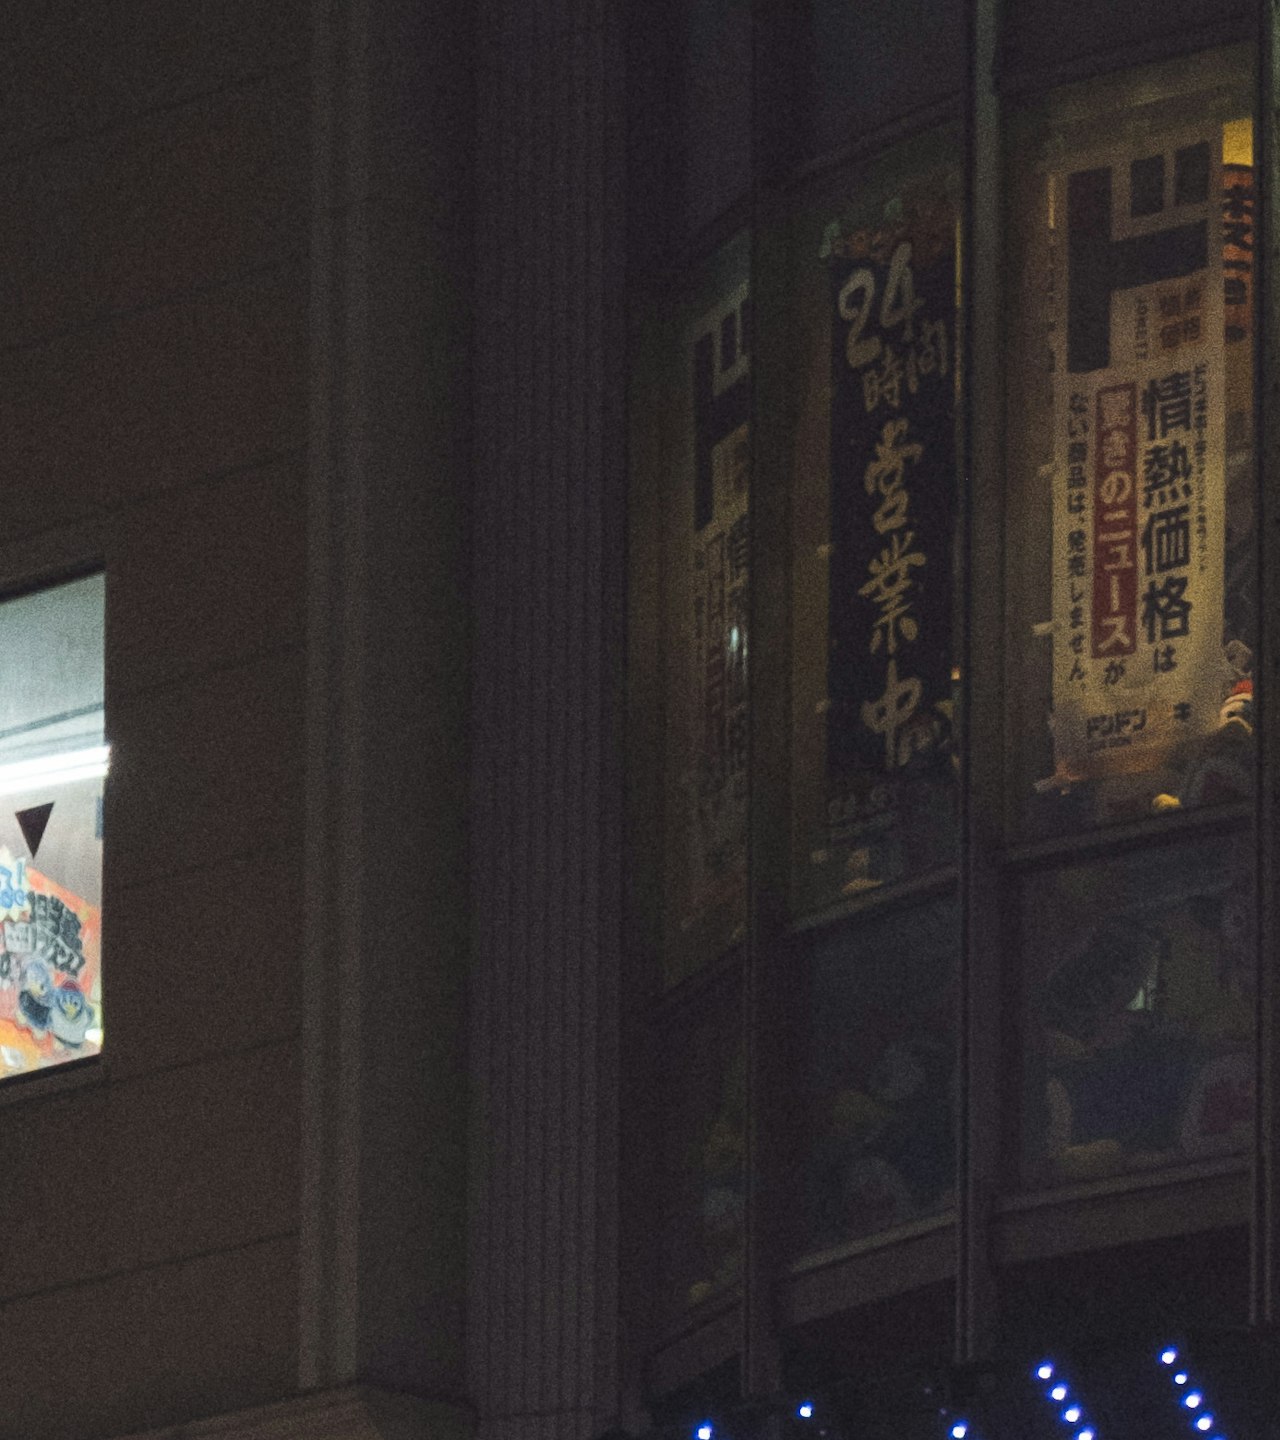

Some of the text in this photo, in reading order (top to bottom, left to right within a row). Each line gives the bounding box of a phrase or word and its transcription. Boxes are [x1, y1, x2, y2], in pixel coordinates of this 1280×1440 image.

[839, 241, 946, 770] 24時間営業中
[1140, 370, 1193, 674] 情熱価格は
